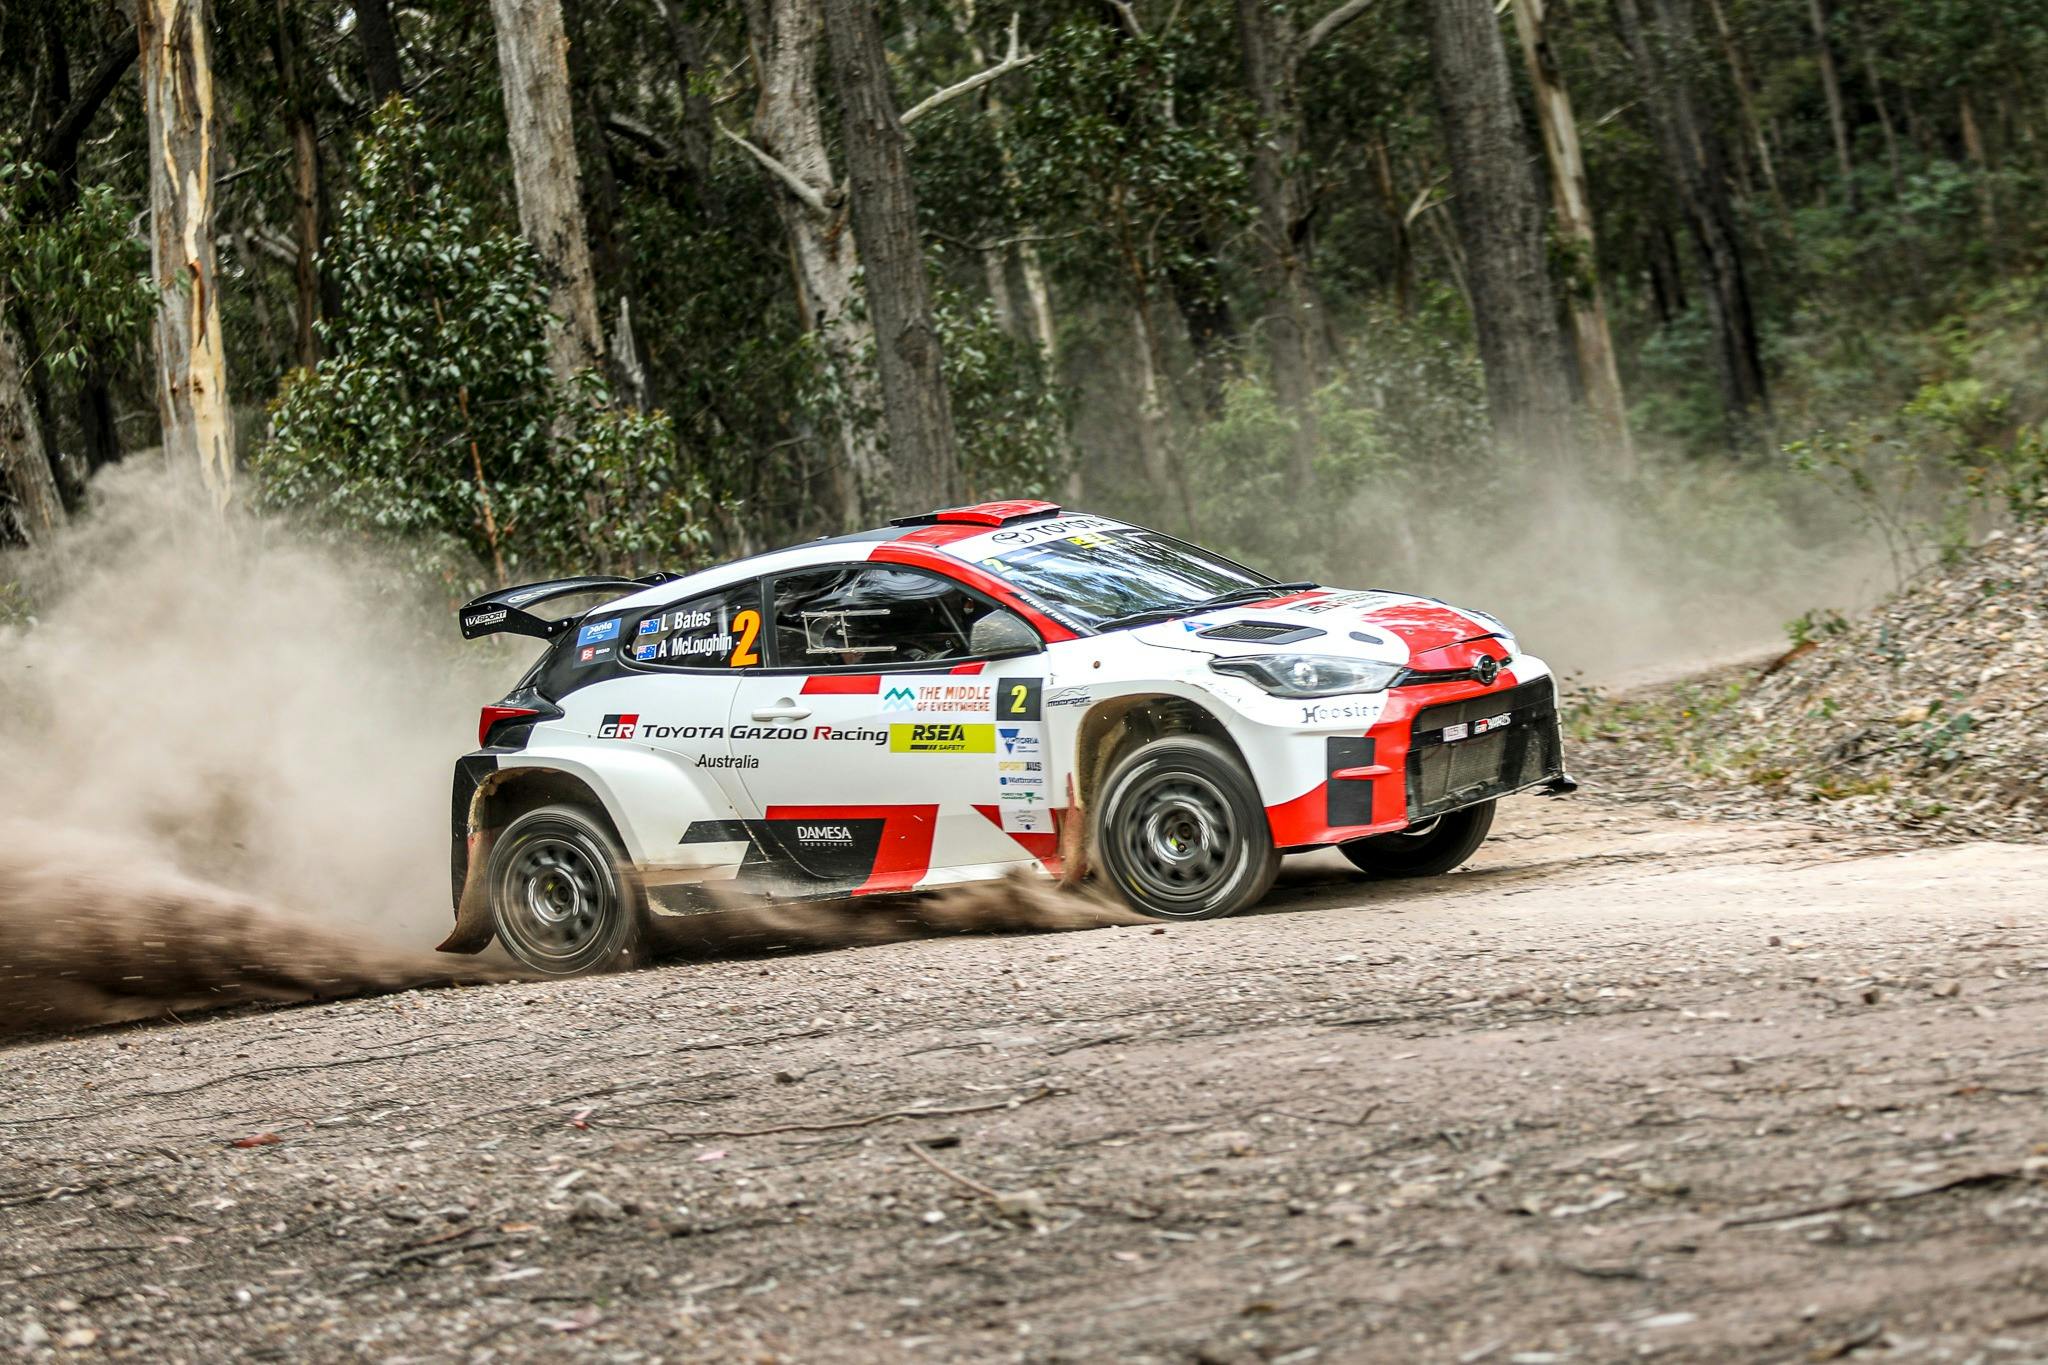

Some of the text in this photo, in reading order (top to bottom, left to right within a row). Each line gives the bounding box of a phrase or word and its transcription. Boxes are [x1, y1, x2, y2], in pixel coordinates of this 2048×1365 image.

[1027, 518, 1109, 537] TOYOTA
[661, 610, 711, 632] L Bates
[658, 632, 732, 658] A McLoughlin
[730, 609, 760, 668] 2
[919, 686, 991, 700] THE MIDDLE
[1010, 684, 1027, 714] 2
[916, 701, 991, 712] OF EVERYWHERE
[599, 724, 888, 746] GR TOYOTA GAZOO Racing
[911, 724, 965, 741] RSEA
[697, 753, 759, 769] Australia
[797, 826, 852, 839] DAMESA
